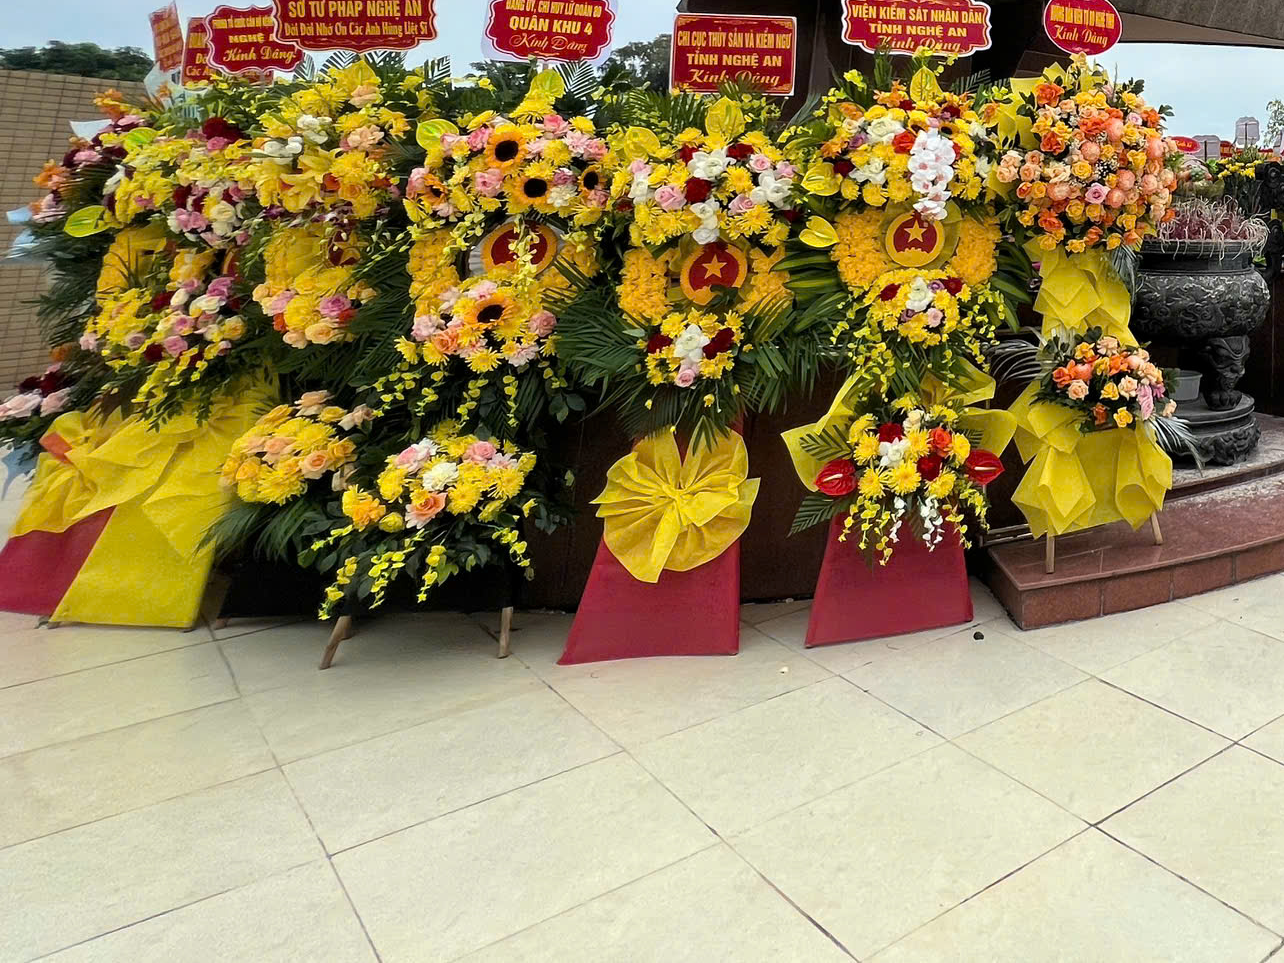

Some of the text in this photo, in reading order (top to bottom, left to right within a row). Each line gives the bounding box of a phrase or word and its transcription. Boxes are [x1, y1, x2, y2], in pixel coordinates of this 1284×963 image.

[309, 0, 326, 18] TƯ
[404, 0, 422, 17] AN
[852, 2, 983, 24] VIỆN KIỂM SÁT NHÂN DÂN
[509, 14, 593, 35] QUÂN KHU 4
[868, 20, 967, 38] TỈNH NGHỆ AN
[1053, 24, 1079, 41] Kính
[677, 30, 690, 46] CHI
[728, 27, 744, 48] SẢN
[686, 47, 782, 69] TỈNH NGHỆ AN
